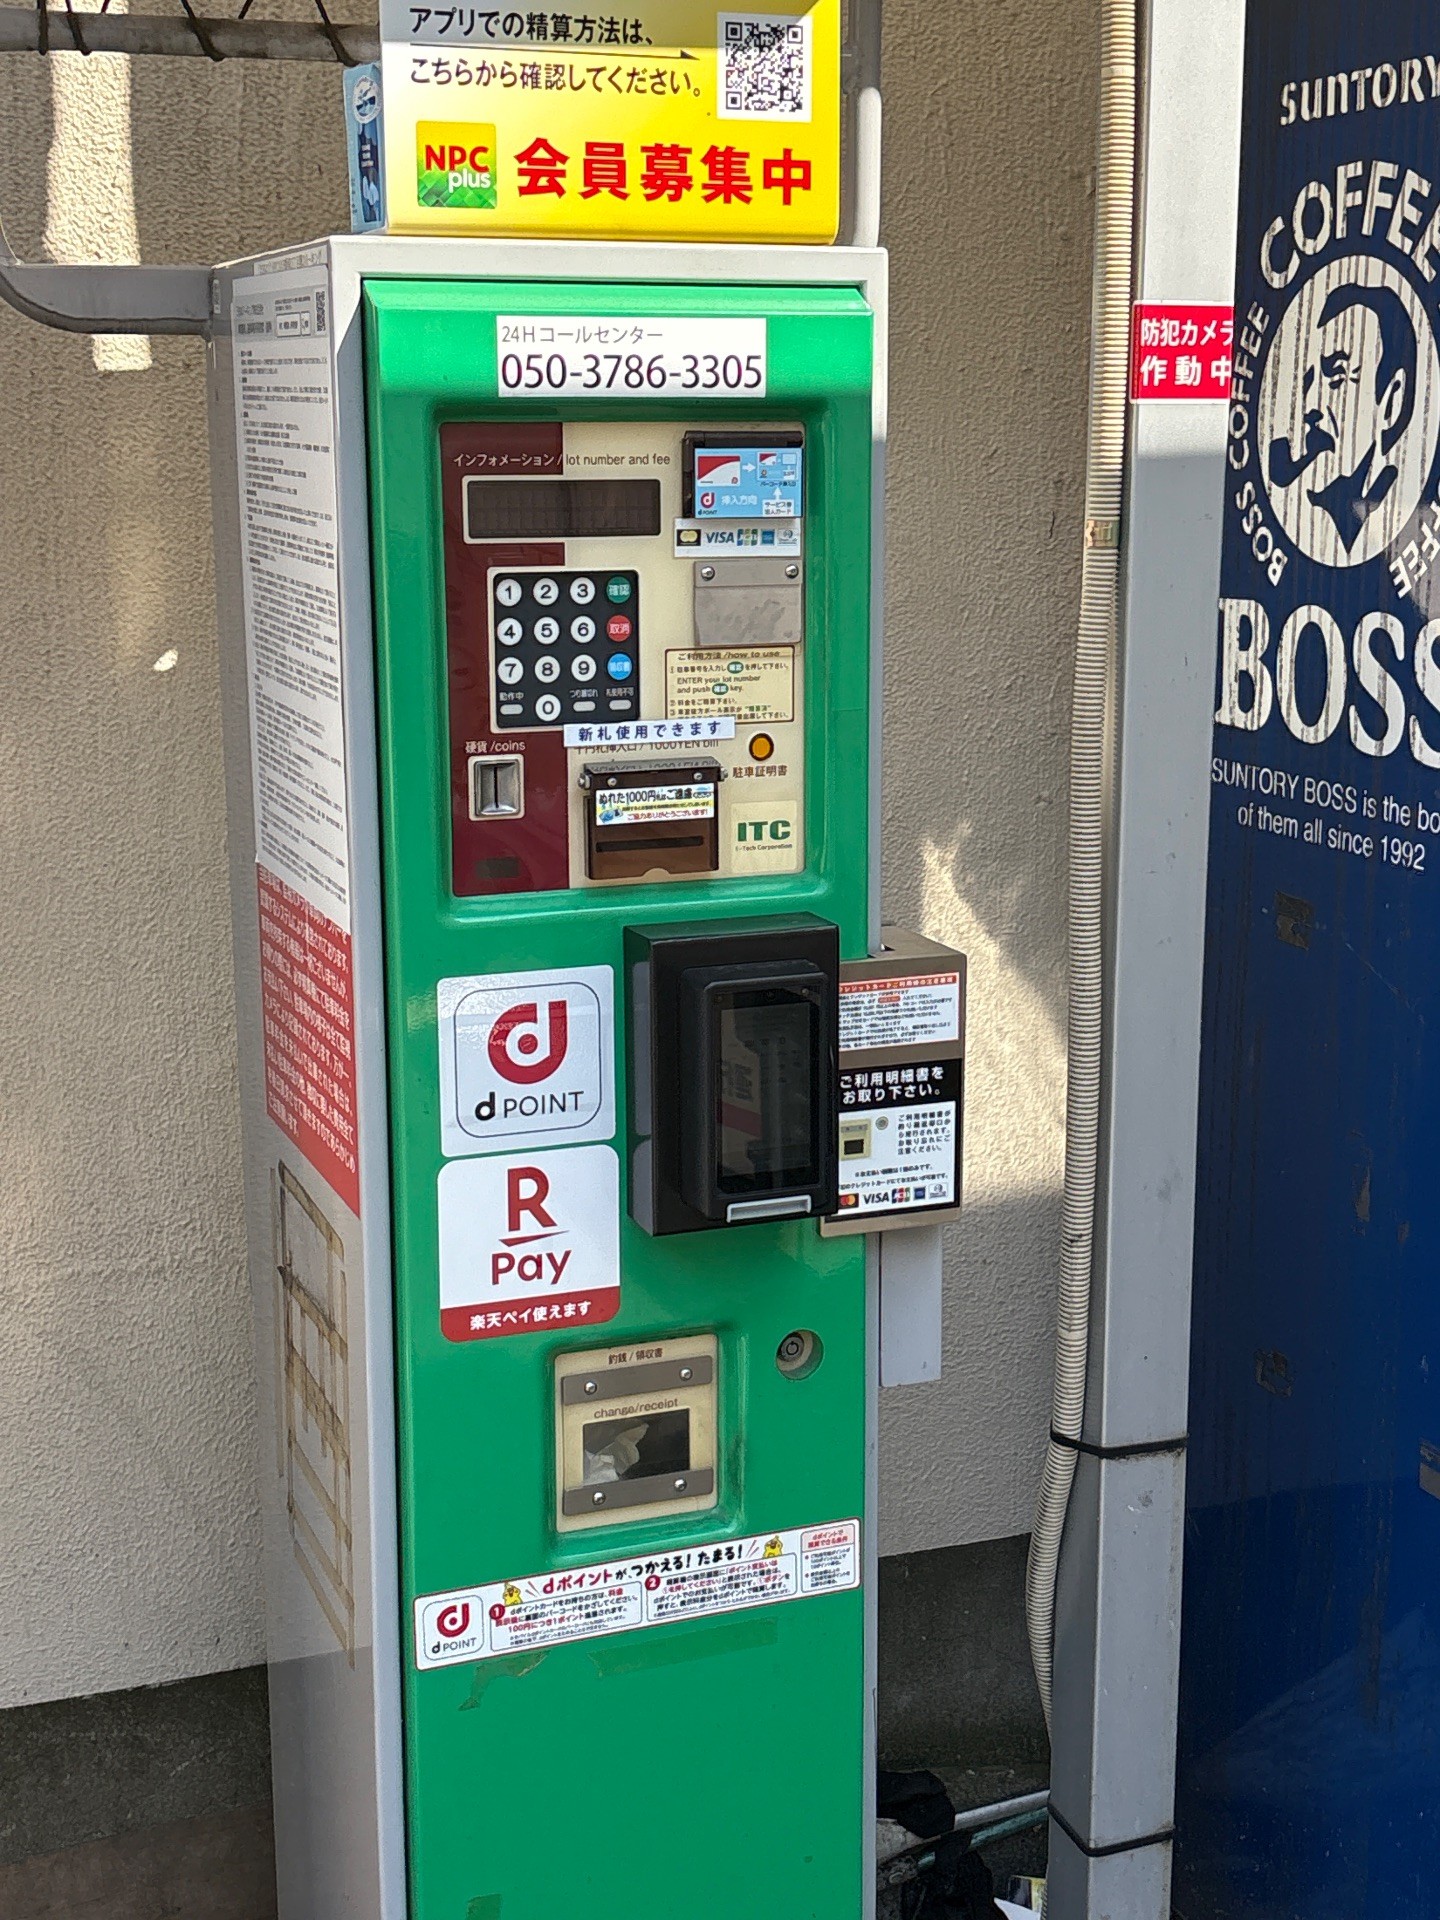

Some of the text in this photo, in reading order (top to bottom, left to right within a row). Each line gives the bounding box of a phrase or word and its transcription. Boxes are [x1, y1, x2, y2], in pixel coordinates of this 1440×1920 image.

[409, 7, 654, 46] アプリでの精算方法は、
[409, 58, 701, 98] こちらから確認してください。
[1279, 55, 1440, 126] SUNTORY
[424, 144, 490, 172] NPC
[448, 168, 492, 193] plus
[514, 137, 812, 206] 会員募集中
[501, 325, 663, 345] 24Hコールセンター
[1140, 318, 1233, 347] 防犯カメラ
[500, 353, 763, 390] 050-3786-3305
[1140, 355, 1232, 387] 作動中
[1228, 301, 1270, 470] COFFEE
[565, 454, 580, 465] lot
[583, 453, 623, 466] number
[628, 453, 649, 465] and
[653, 453, 671, 465] fee
[706, 531, 735, 544] VISA
[1235, 481, 1288, 587] BOSS
[506, 585, 512, 600] 1
[540, 584, 552, 599] 2
[577, 583, 588, 598] 3
[504, 624, 516, 639] 4
[541, 623, 552, 638] 5
[577, 622, 589, 637] 6
[505, 663, 516, 678] 7
[541, 662, 554, 677] 8
[578, 661, 590, 676] 9
[676, 677, 703, 685] ENTER
[692, 686, 711, 694] push
[542, 700, 554, 715] 0
[578, 720, 721, 742] 新札使用できます
[732, 764, 788, 778] 駐車証明書
[1210, 757, 1300, 801] SUNTORY
[1303, 777, 1358, 814] BOSS
[1362, 789, 1377, 819] is
[1382, 795, 1411, 827] the
[737, 820, 791, 841] ITC
[1236, 801, 1426, 872] of them all since 1992
[840, 1066, 944, 1089] ご利用明細書を
[504, 1090, 585, 1119] POINT
[842, 1083, 941, 1105] お取り下さい。
[507, 1165, 558, 1232] R
[862, 1191, 890, 1204] VISA
[491, 1249, 572, 1286] Pay
[469, 1300, 593, 1332] 楽天ペイ使えます
[443, 1637, 478, 1652] POINT
